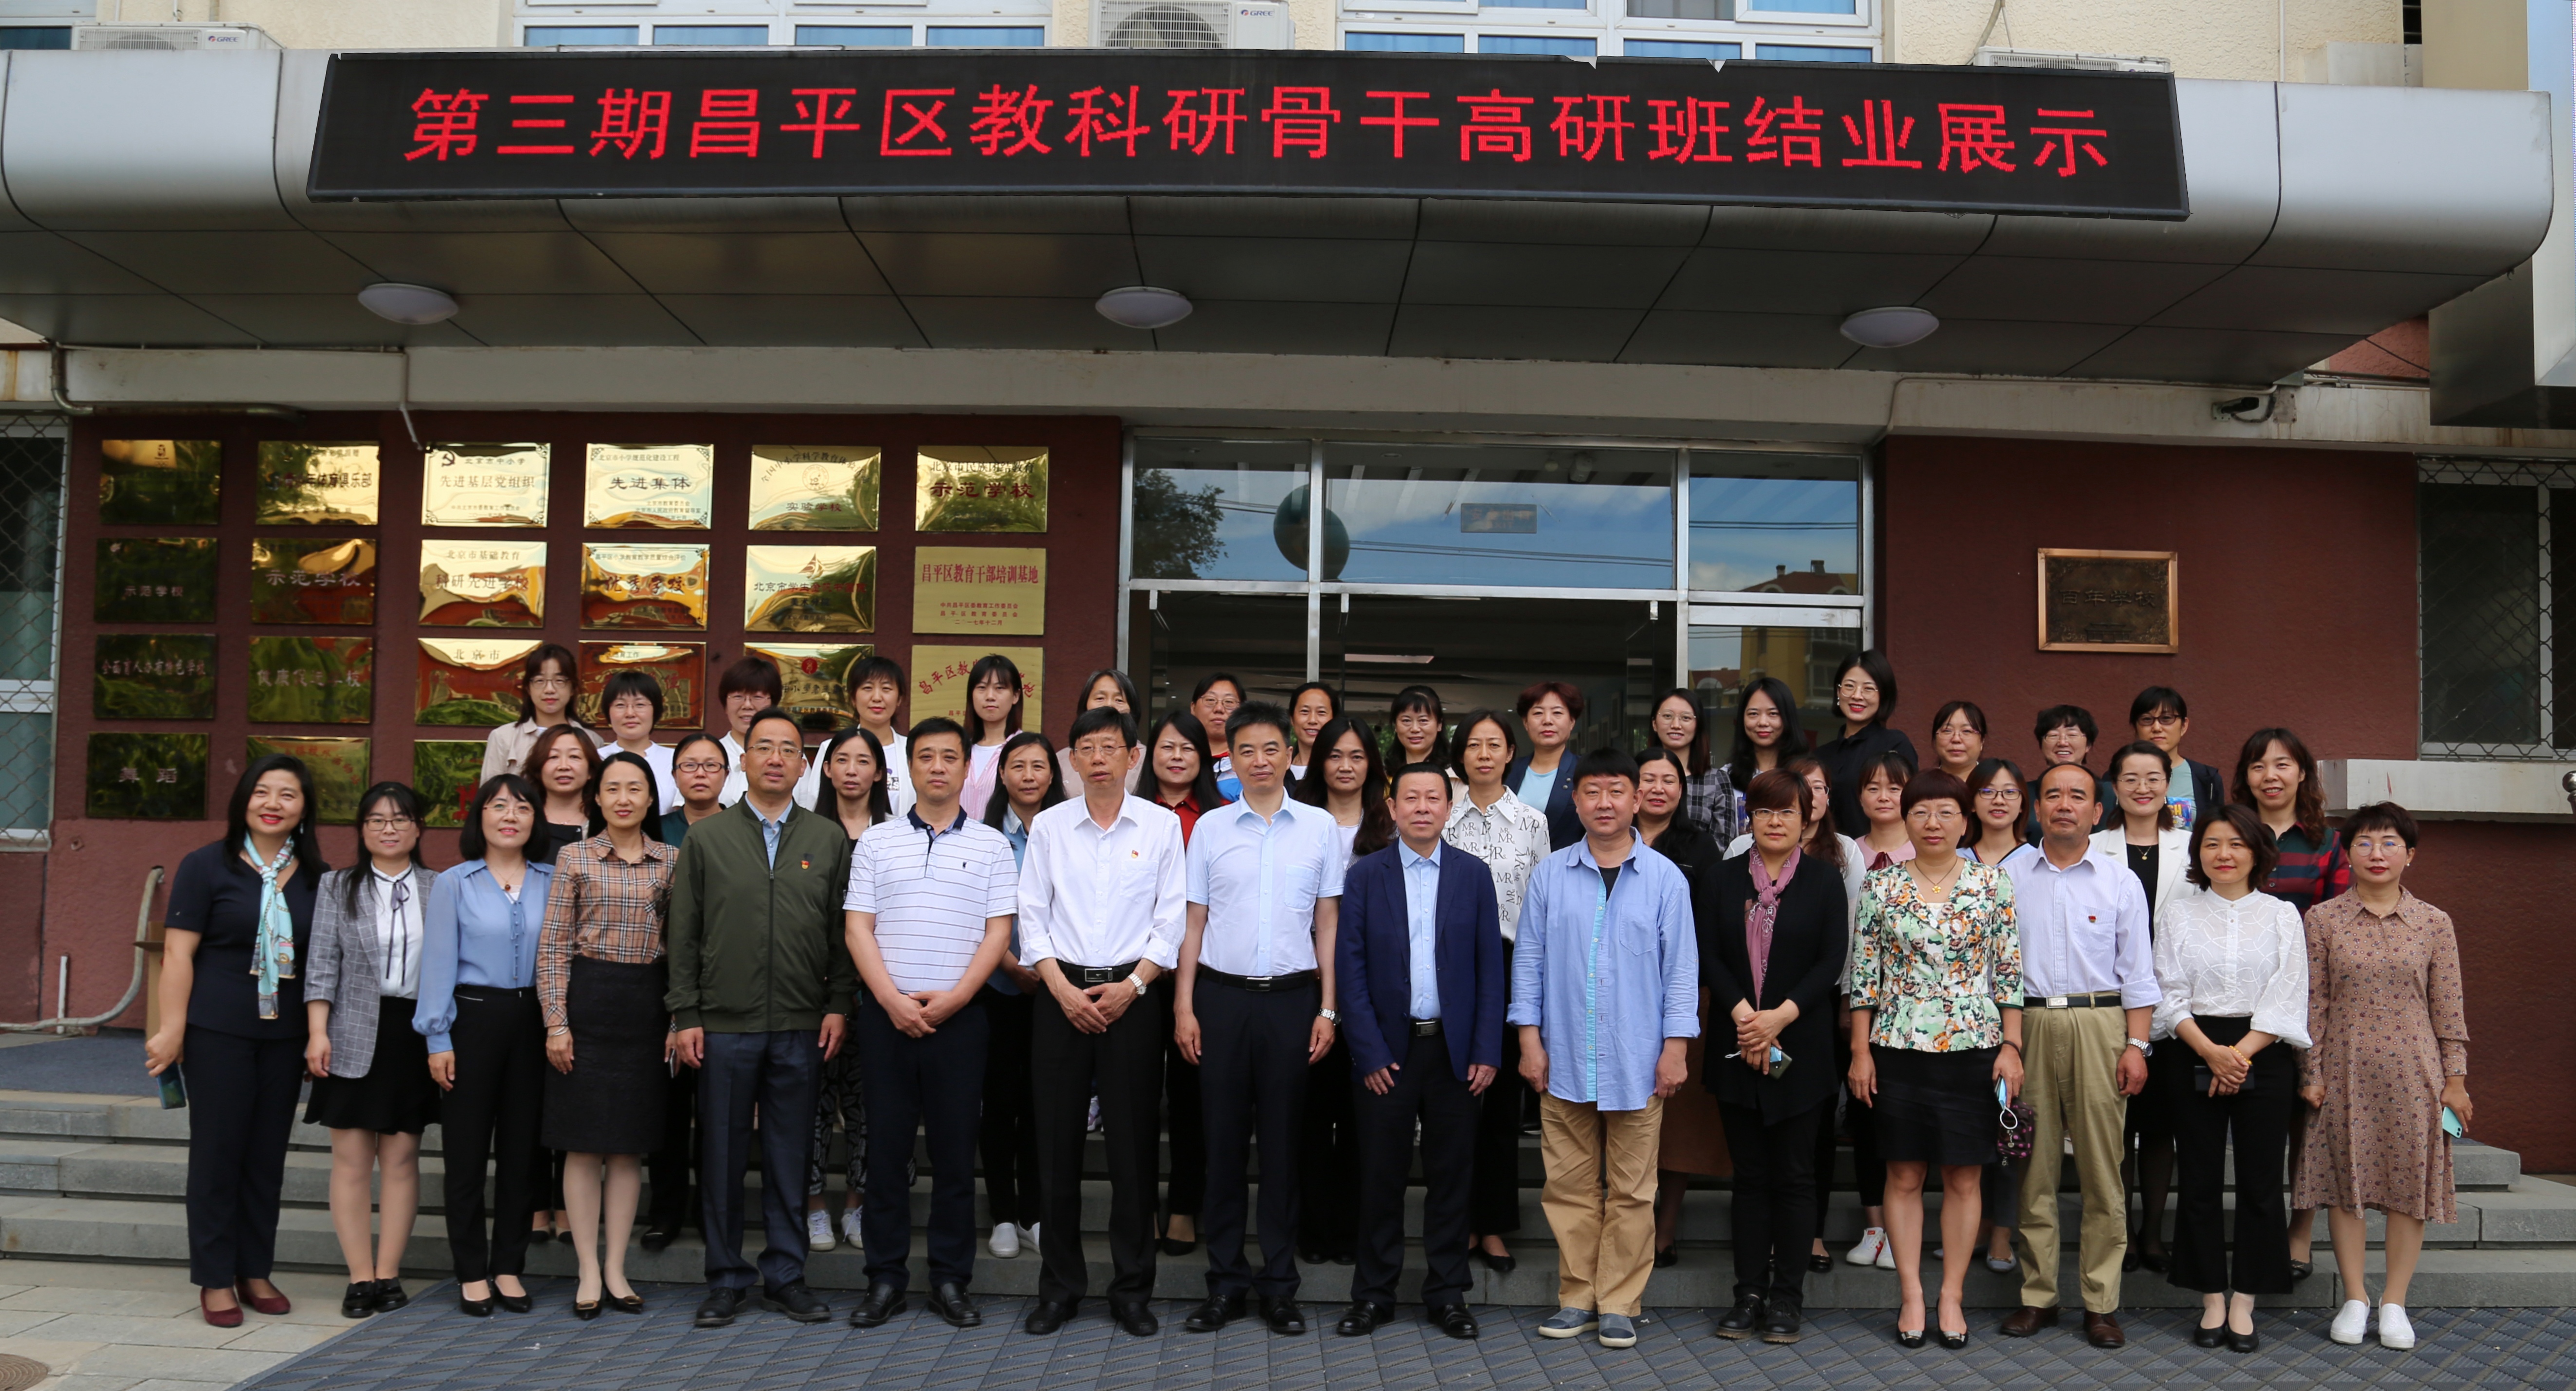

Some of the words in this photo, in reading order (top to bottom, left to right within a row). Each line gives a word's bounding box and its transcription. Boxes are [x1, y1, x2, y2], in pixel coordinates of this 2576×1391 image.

[404, 83, 2108, 177] 第三期昌平区教科研骨干高研班结业展示
[931, 461, 1034, 473] 北京市民族团结教育
[439, 475, 535, 488] 先进基层党组织
[609, 477, 692, 490] 先进集体
[930, 482, 1035, 499] 示范学校
[785, 502, 842, 512] 实验学校
[447, 549, 520, 560] 北京市基础教育
[265, 569, 362, 587] 示范学校
[922, 564, 1039, 584] 昌平区教育干部培训基地
[435, 573, 529, 591] 科研先进学校
[124, 585, 183, 597] 示范学校
[2059, 589, 2157, 608] 百年学校
[454, 649, 500, 660] 北京市
